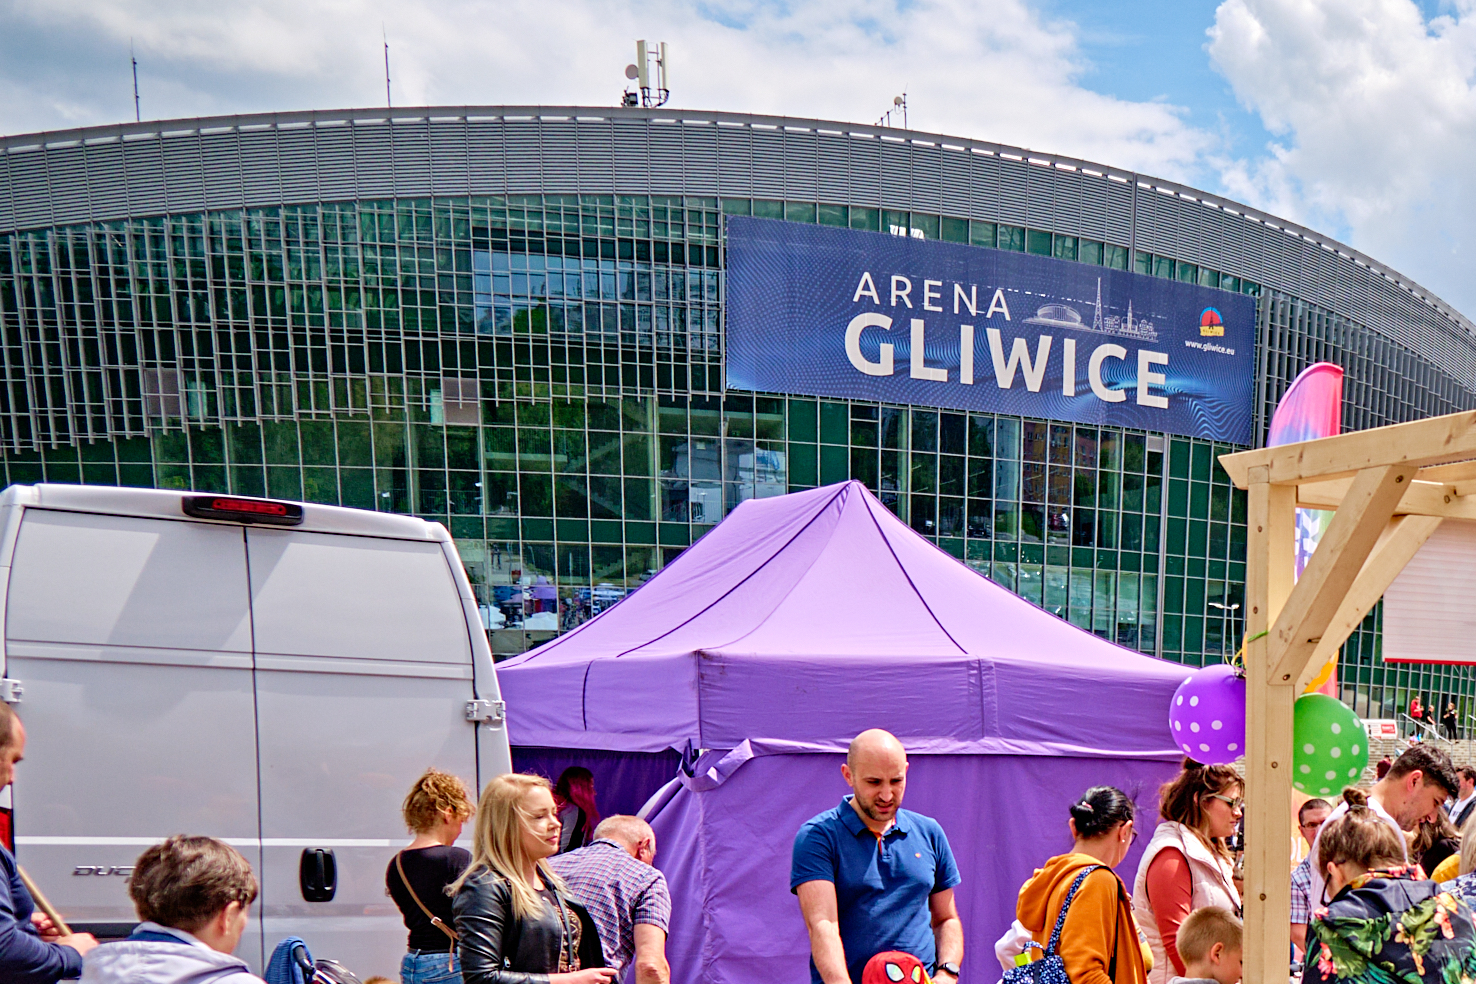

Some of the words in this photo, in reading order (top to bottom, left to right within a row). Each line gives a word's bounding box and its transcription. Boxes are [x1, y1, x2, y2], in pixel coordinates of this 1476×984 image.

[852, 271, 1011, 321] ARENA
[844, 312, 1169, 409] GLIWICE
[1184, 340, 1235, 356] www.gliwice.eu
